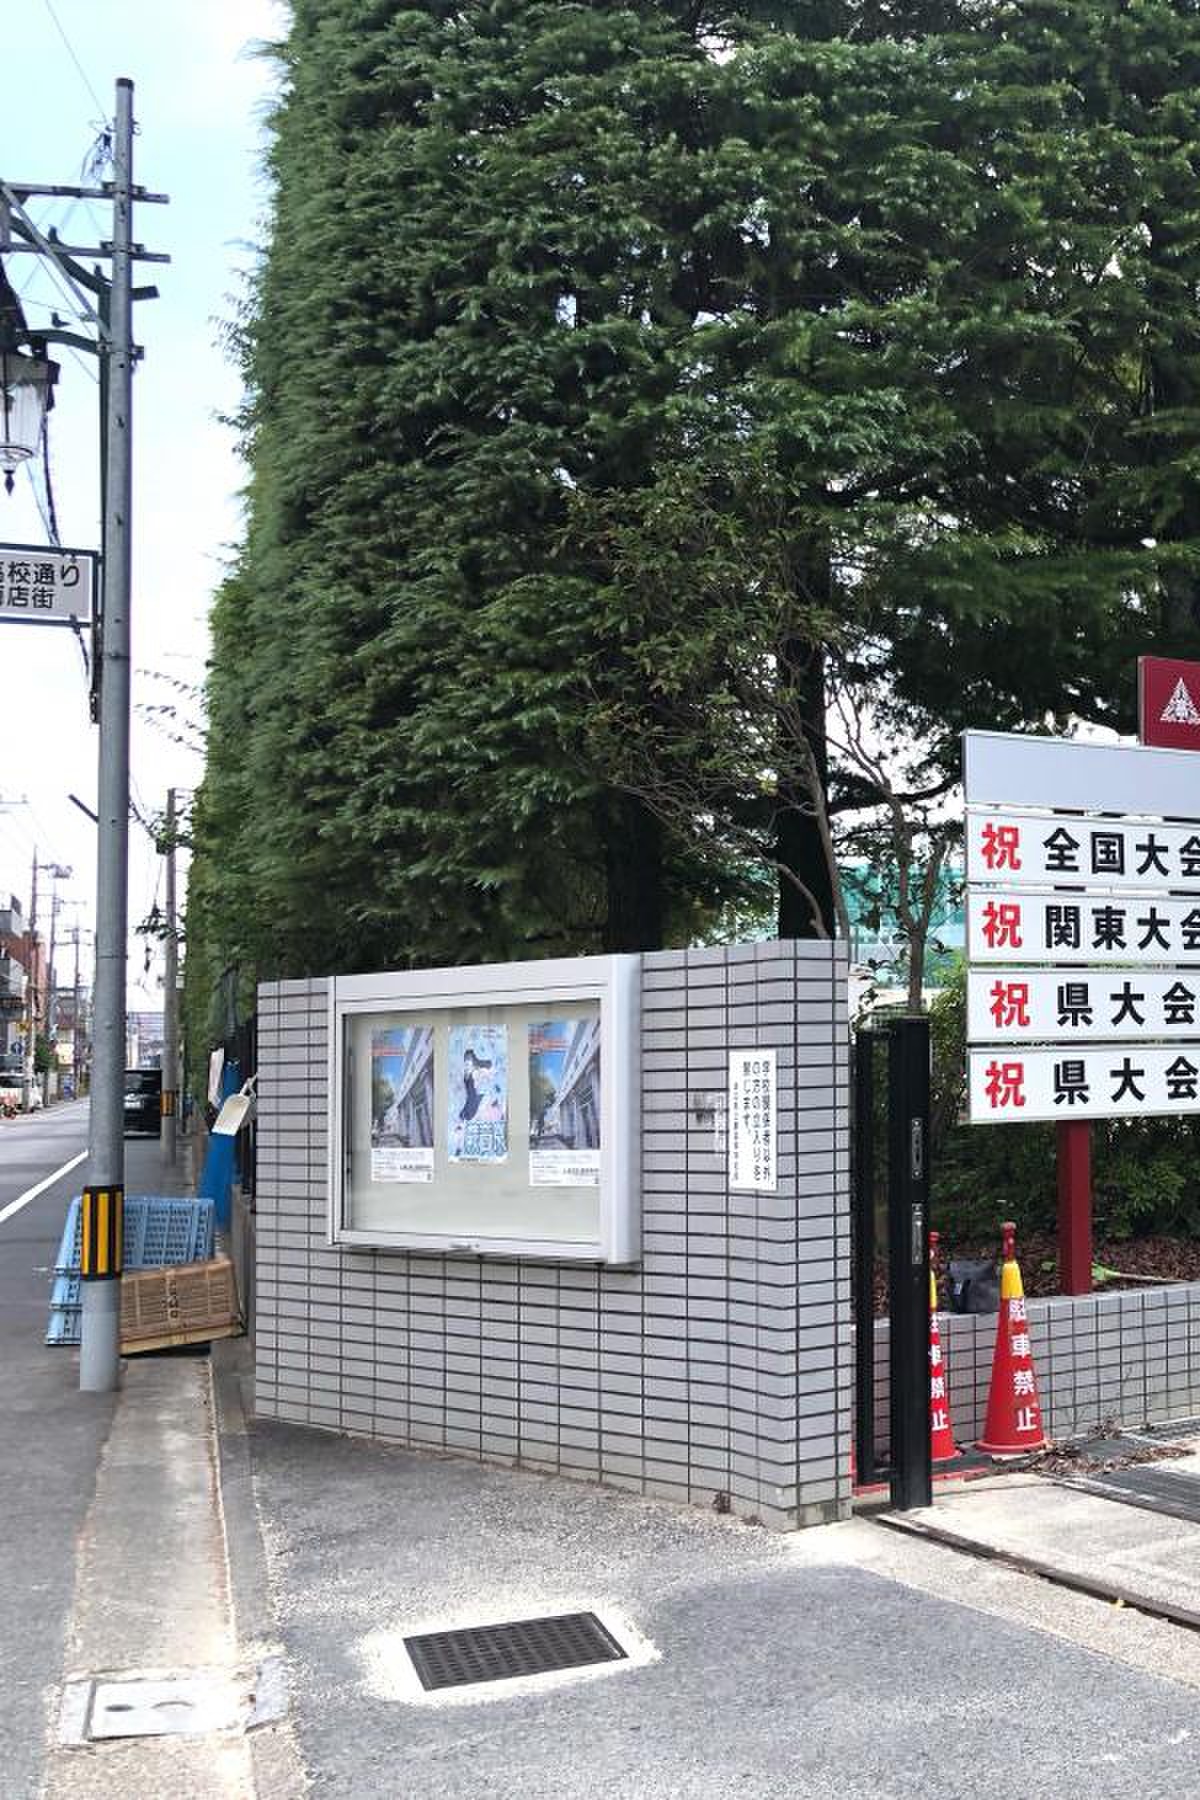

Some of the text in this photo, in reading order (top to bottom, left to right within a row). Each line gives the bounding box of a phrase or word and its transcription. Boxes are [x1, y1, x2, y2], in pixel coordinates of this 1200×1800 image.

[0, 561, 80, 587] 校通り
[0, 585, 54, 609] 店街
[981, 823, 1022, 871] 祝
[982, 901, 1023, 949] 祝
[989, 980, 1030, 1028] 祝
[985, 1061, 1025, 1108] 祝
[1008, 1297, 1037, 1432] 駐車禁止
